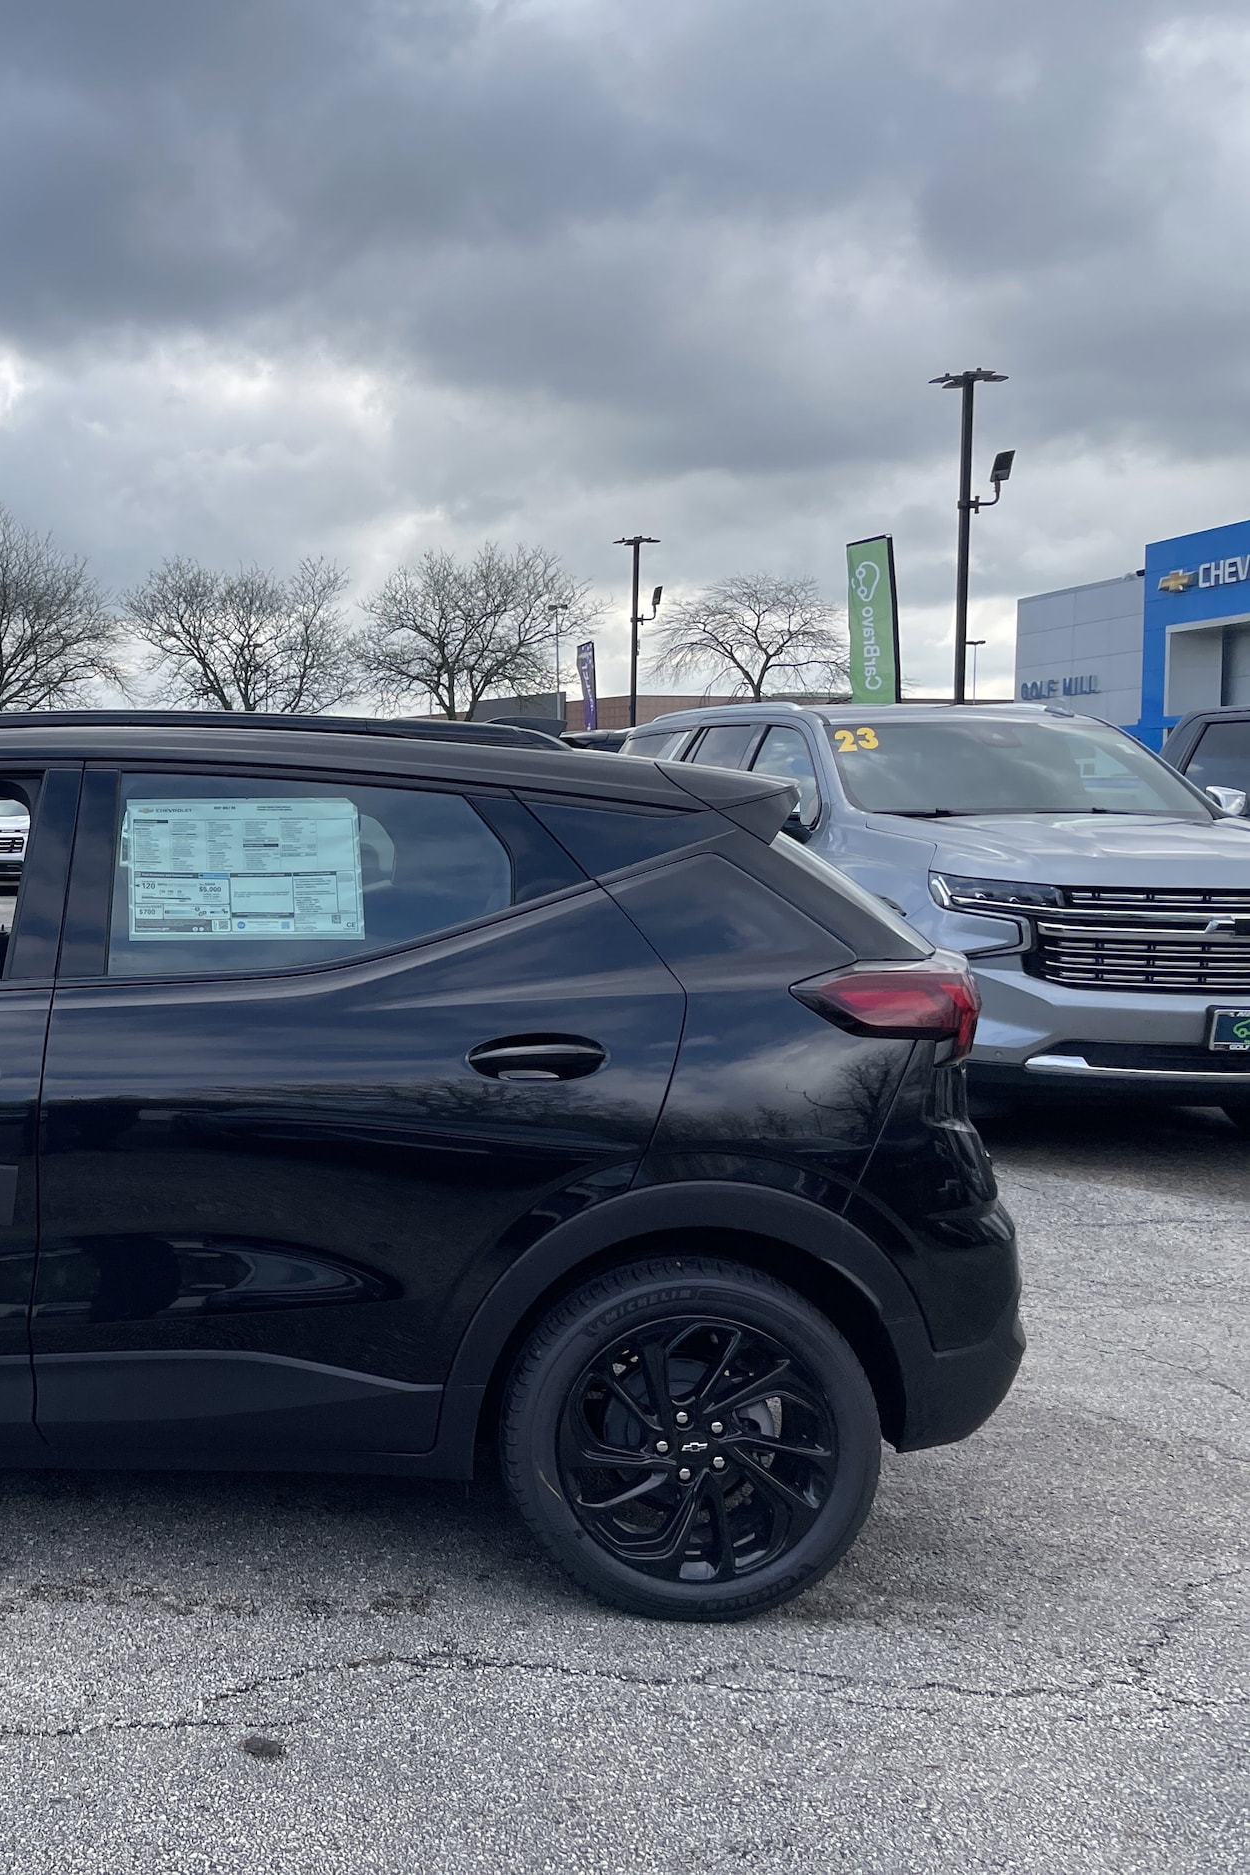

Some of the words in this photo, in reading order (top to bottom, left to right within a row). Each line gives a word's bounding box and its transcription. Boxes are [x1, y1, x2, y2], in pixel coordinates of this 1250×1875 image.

[1198, 554, 1250, 588] CHEV
[1021, 679, 1059, 700] GOLF
[1063, 675, 1102, 696] MILL
[834, 727, 879, 753] 23
